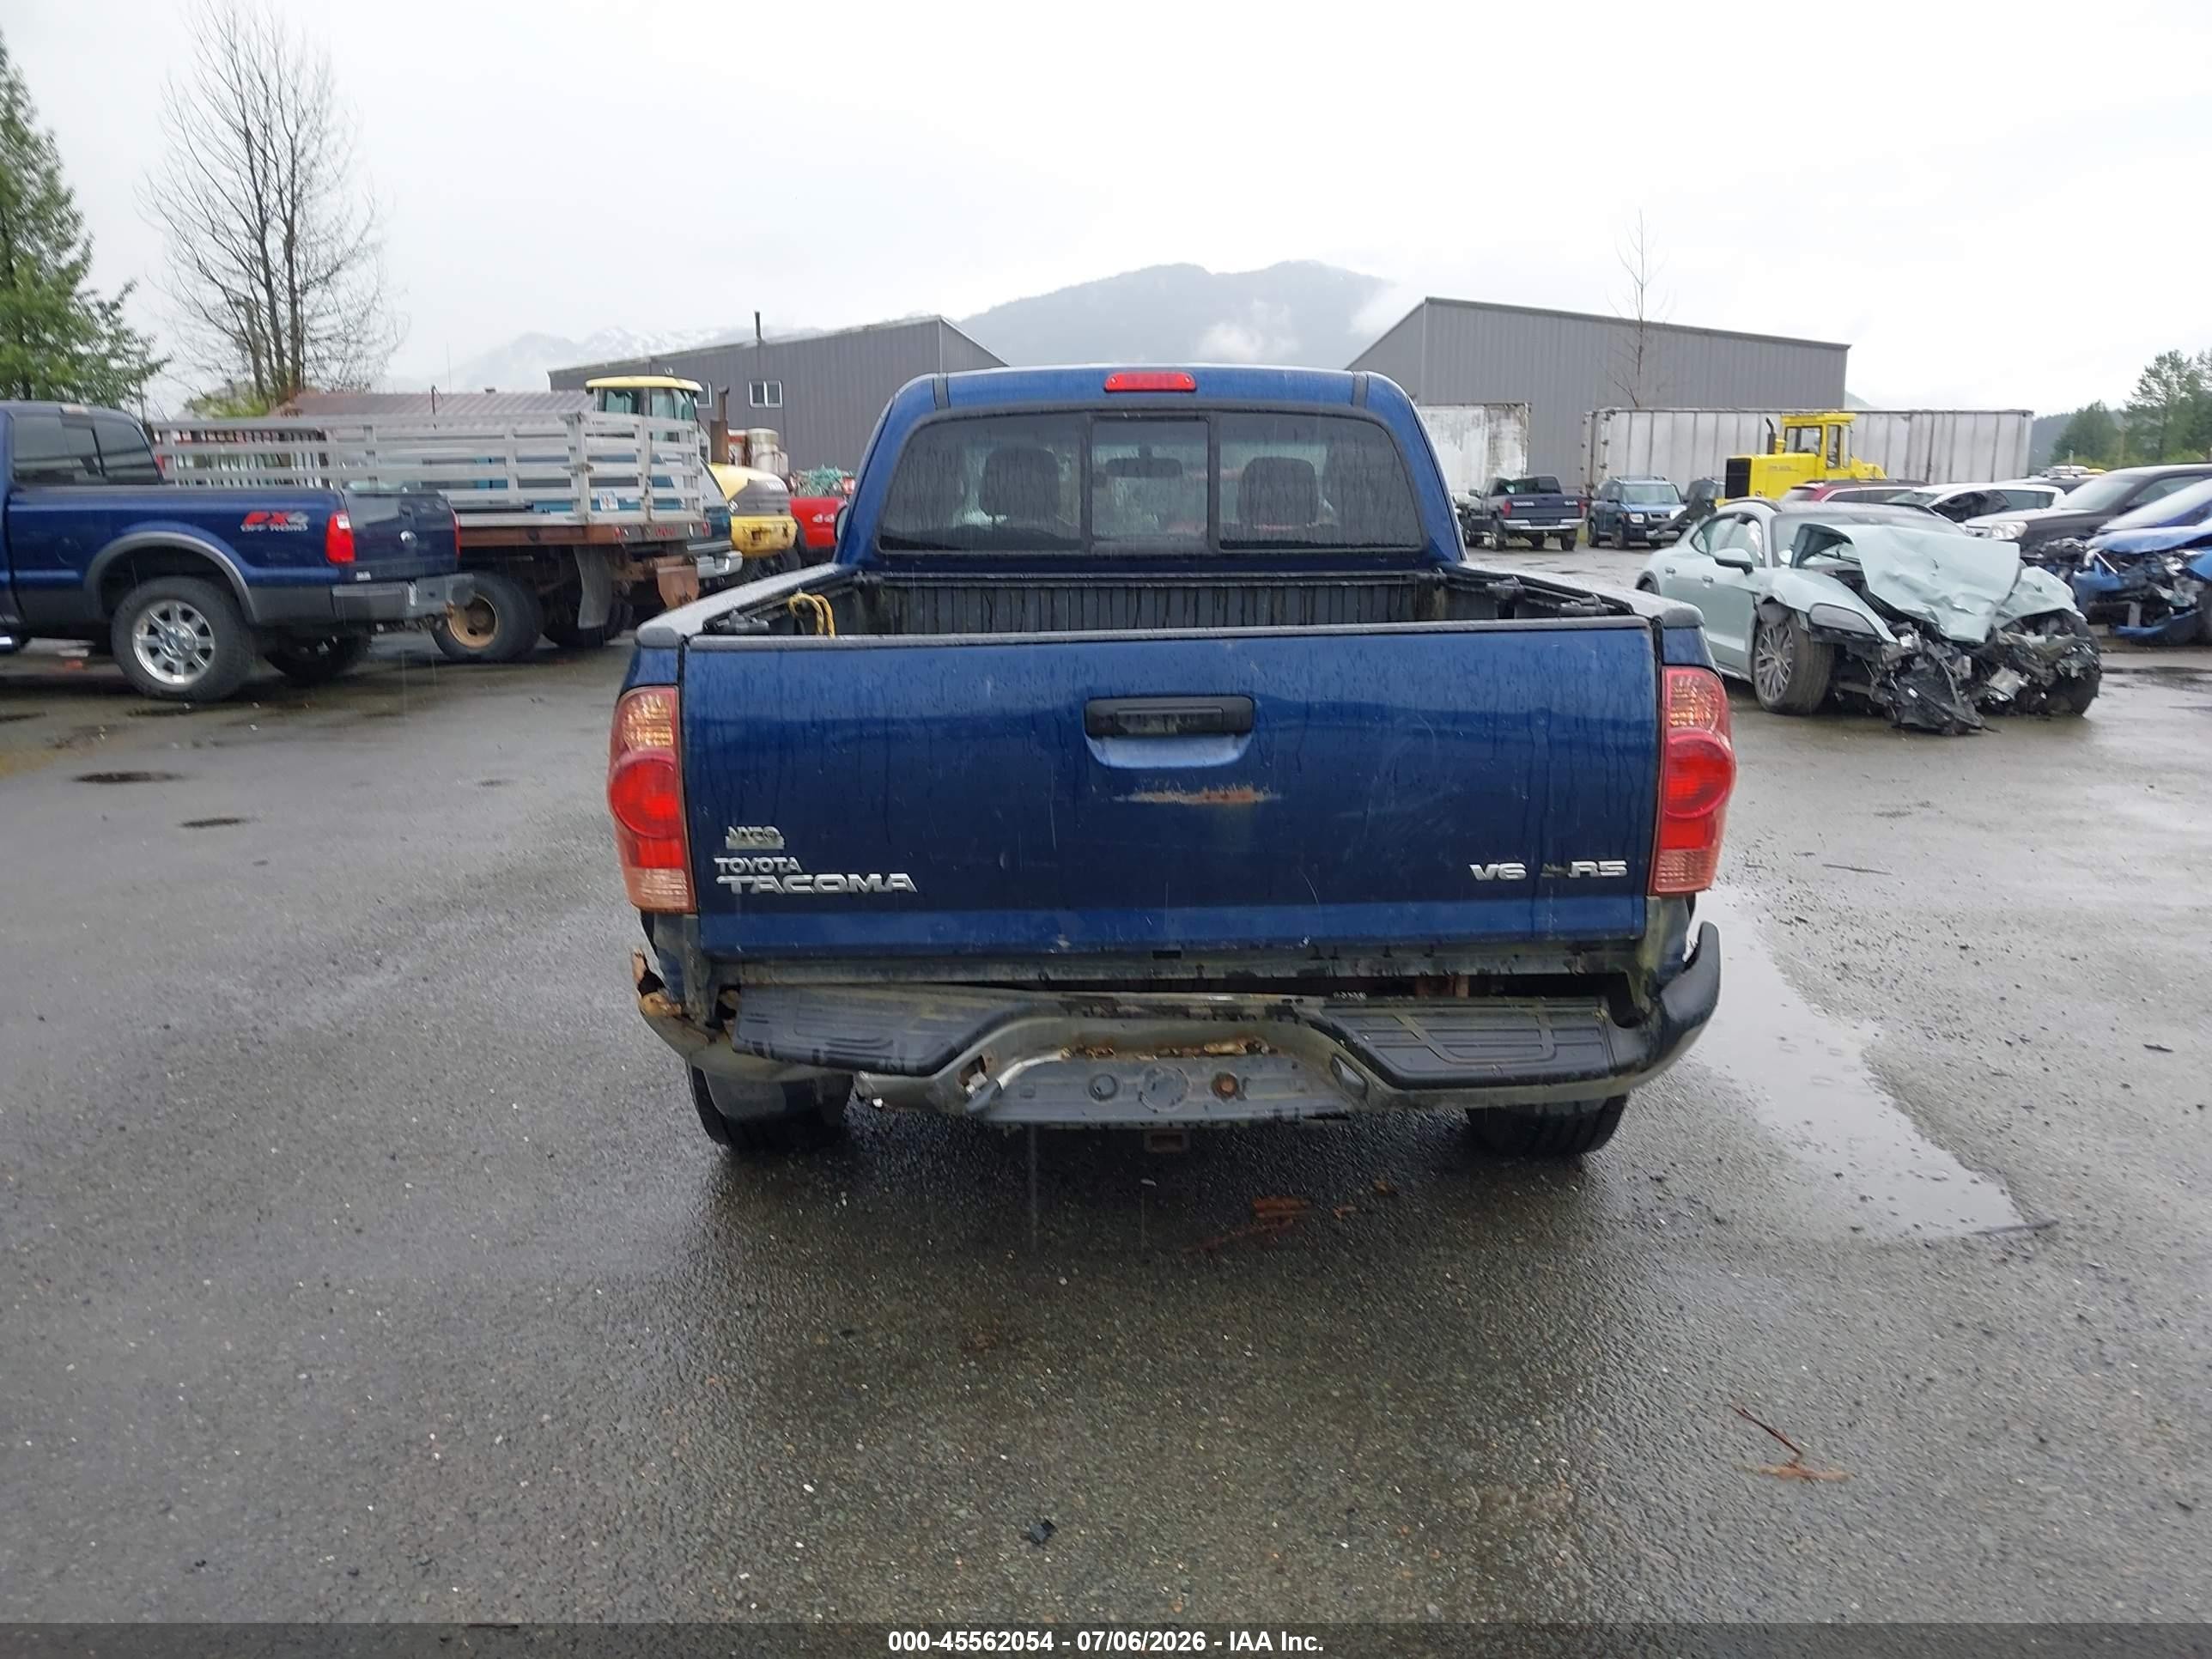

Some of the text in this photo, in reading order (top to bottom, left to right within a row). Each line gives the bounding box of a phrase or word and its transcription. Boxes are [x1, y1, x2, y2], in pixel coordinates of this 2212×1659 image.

[714, 856, 803, 873] TOYOTA
[1469, 860, 1628, 881] V6 R5
[716, 872, 918, 894] TACOMA
